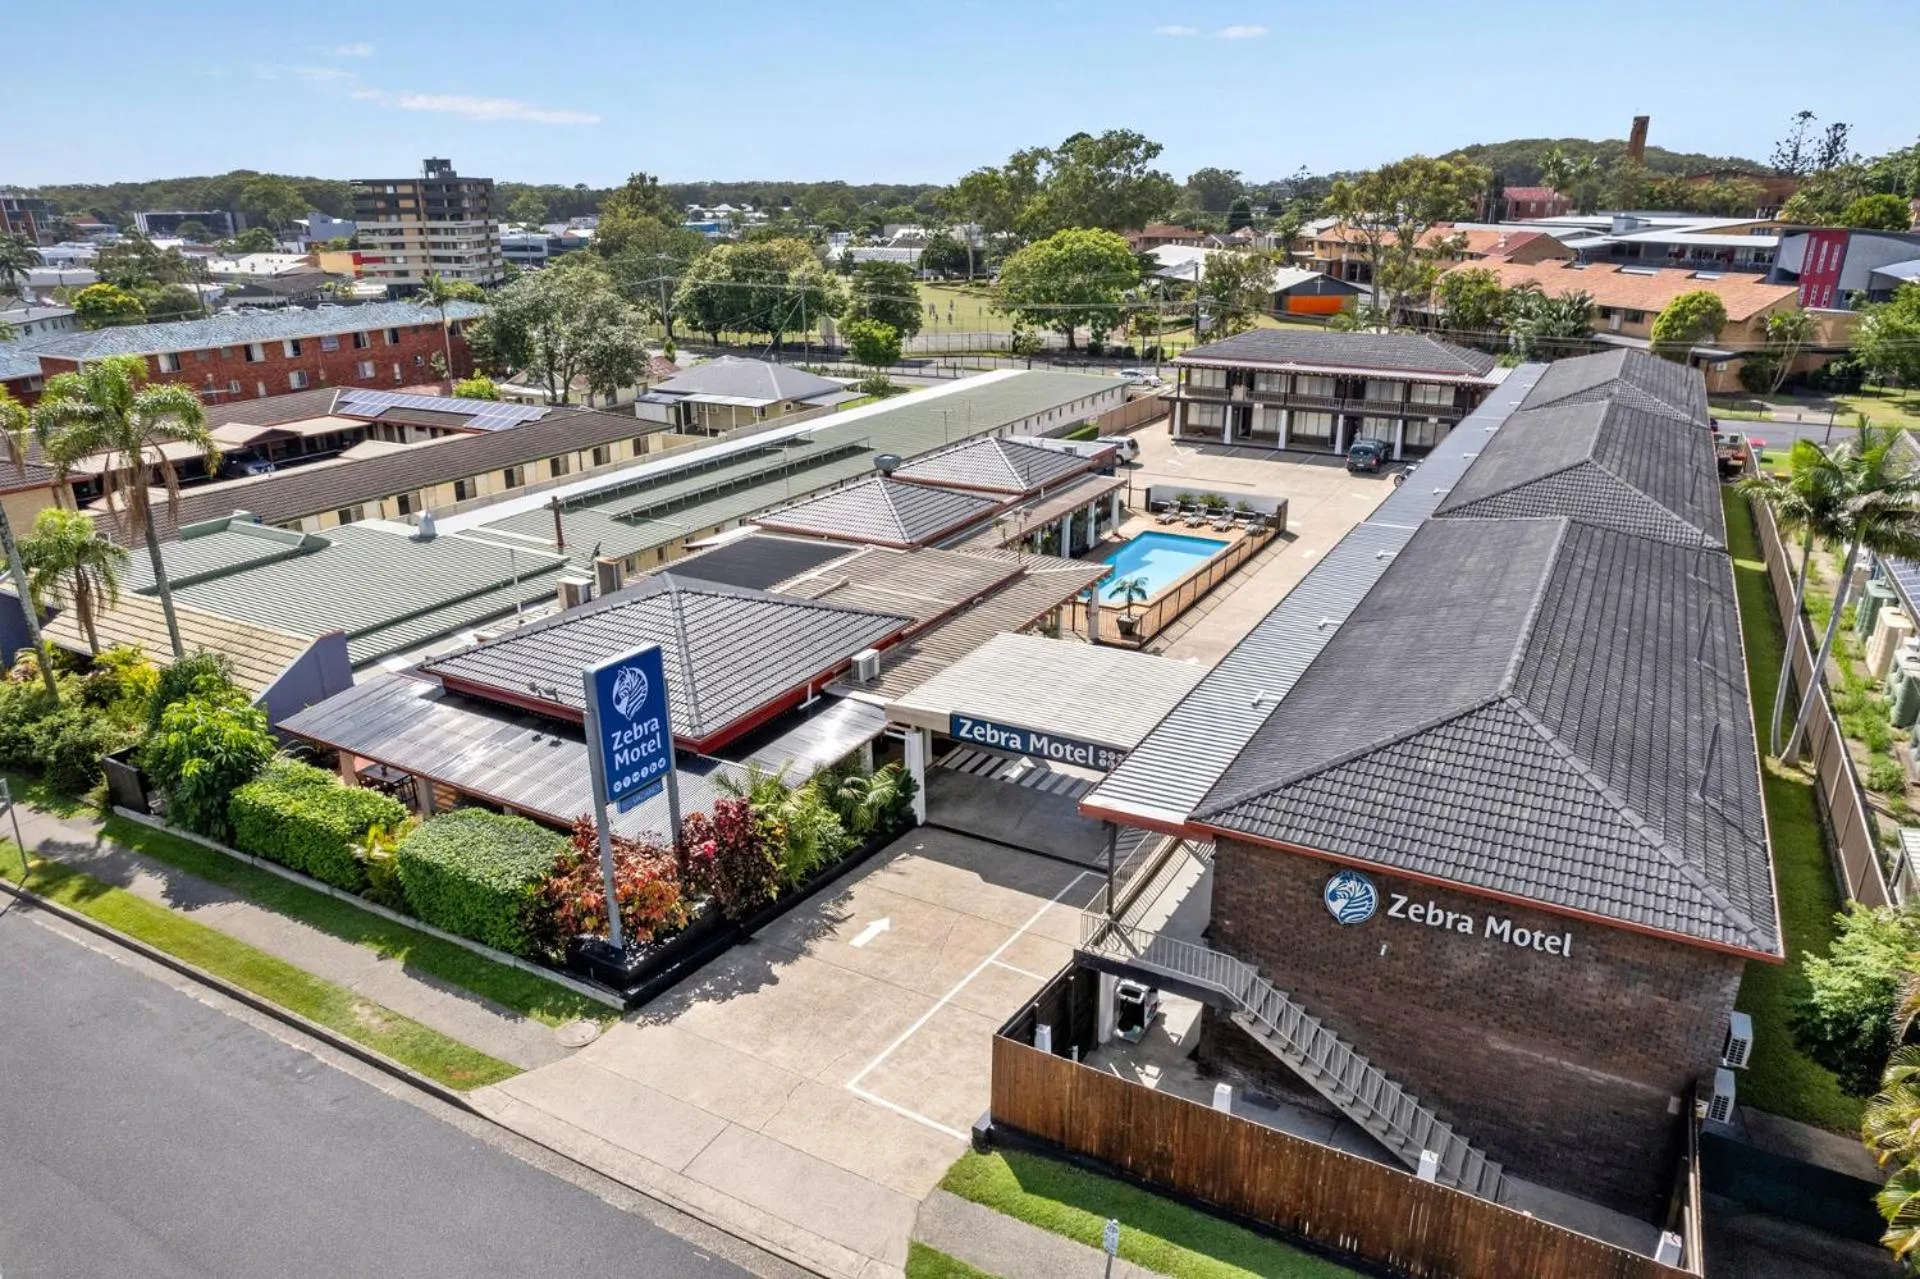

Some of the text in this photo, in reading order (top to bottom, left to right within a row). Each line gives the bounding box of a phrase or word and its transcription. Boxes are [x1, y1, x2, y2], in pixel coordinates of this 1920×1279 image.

[611, 717, 660, 752] Zebra
[614, 732, 662, 771] Motel
[958, 718, 1095, 766] Zebra Motel
[1387, 893, 1572, 958] Zebra Motel
